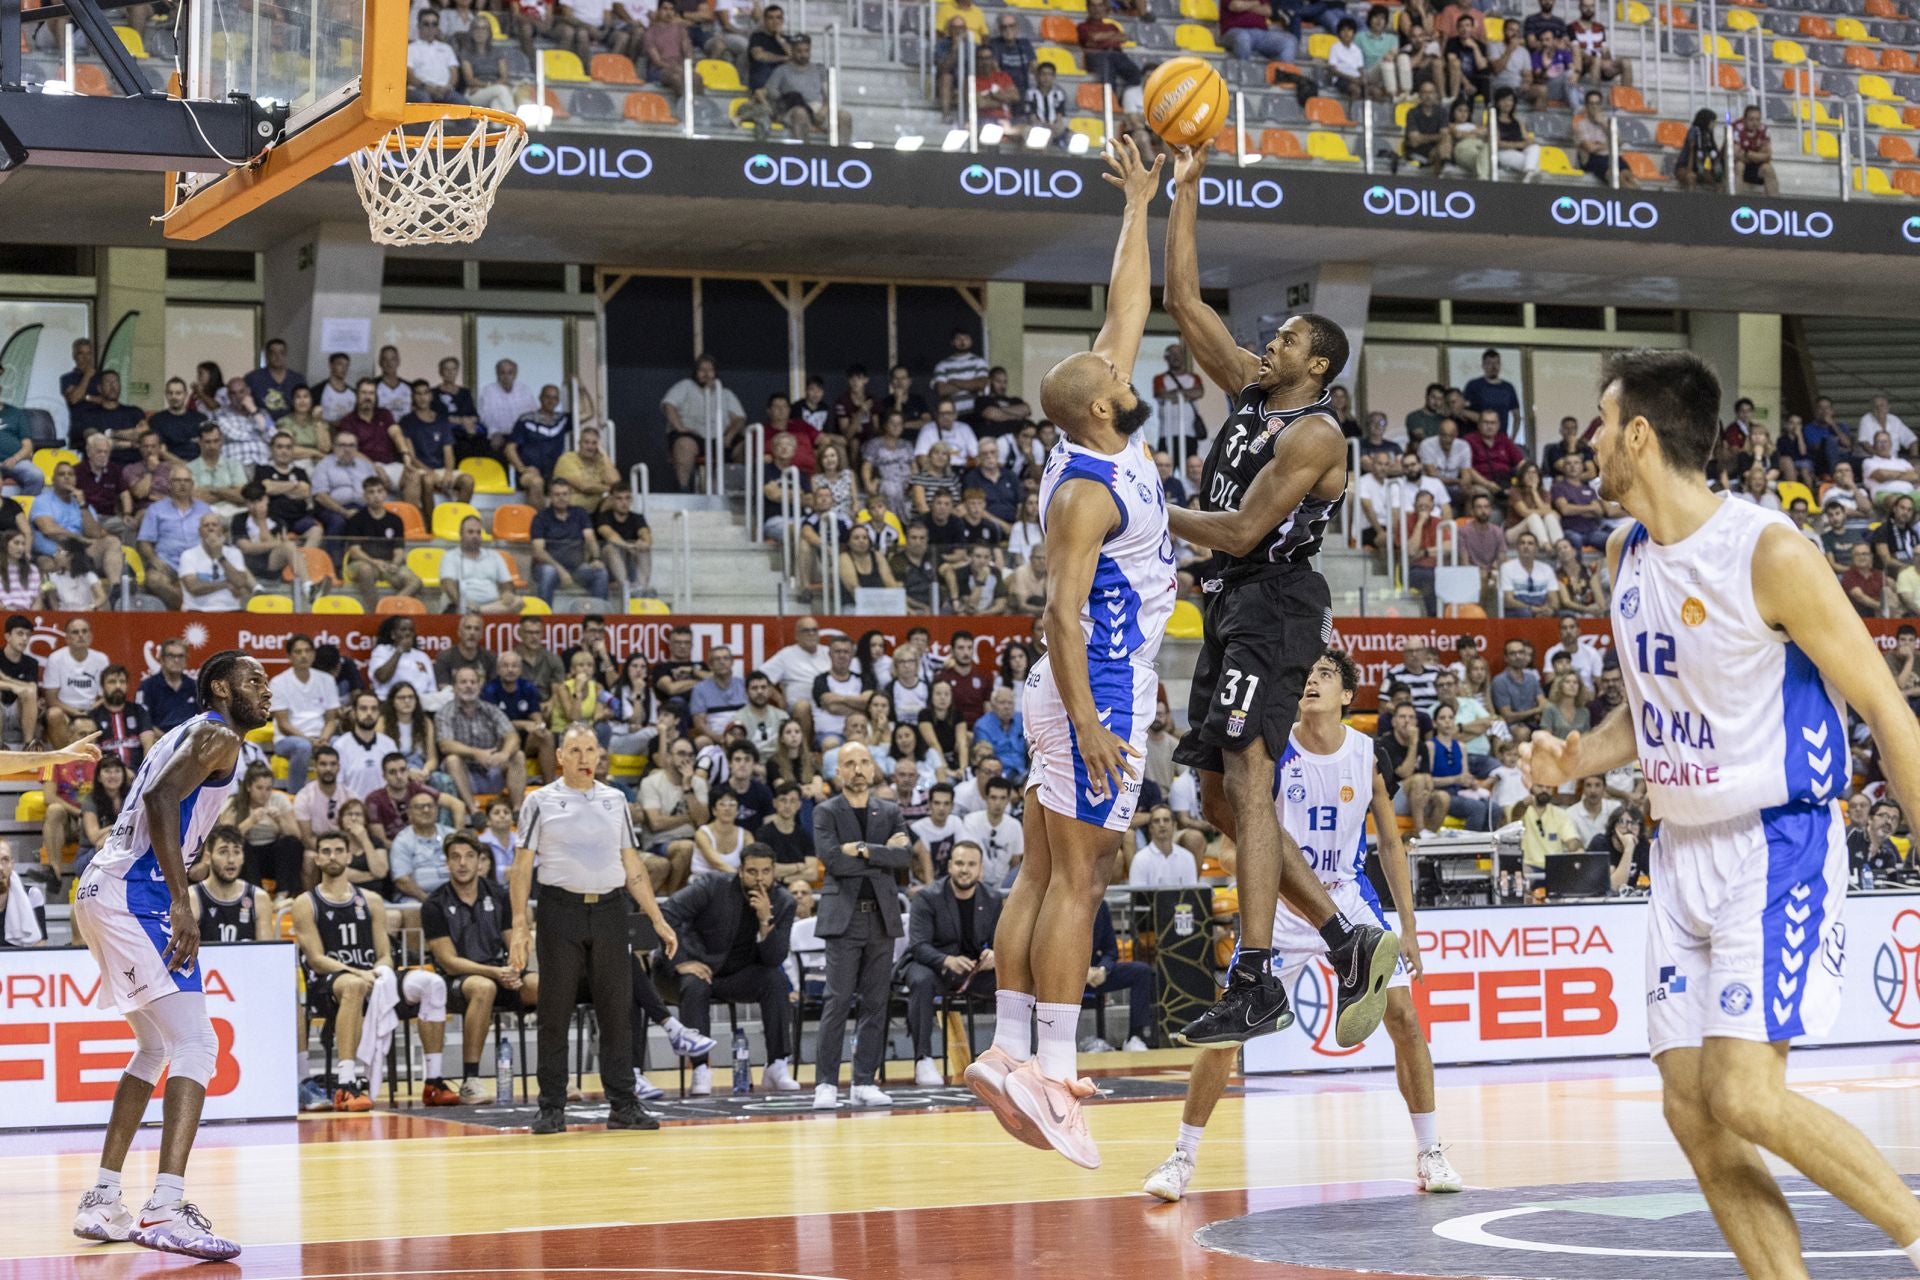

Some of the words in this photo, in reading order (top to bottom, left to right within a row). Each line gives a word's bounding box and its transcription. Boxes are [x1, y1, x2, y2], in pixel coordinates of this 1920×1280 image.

[519, 143, 653, 180] ODILO
[743, 154, 873, 189] ODILO
[960, 164, 1083, 199] ODILO
[1363, 186, 1476, 219] ODILO
[1551, 196, 1659, 229] ODILO
[1731, 206, 1834, 239] ODILO
[238, 630, 294, 649] Puer
[541, 623, 673, 663] HABNEROS
[1636, 631, 1679, 679] 12
[1220, 668, 1259, 712] 31
[1671, 709, 1716, 749] HLA
[1307, 805, 1338, 832] 13
[218, 922, 237, 942] 10
[338, 922, 357, 946] 11
[1411, 966, 1619, 1044] FEB
